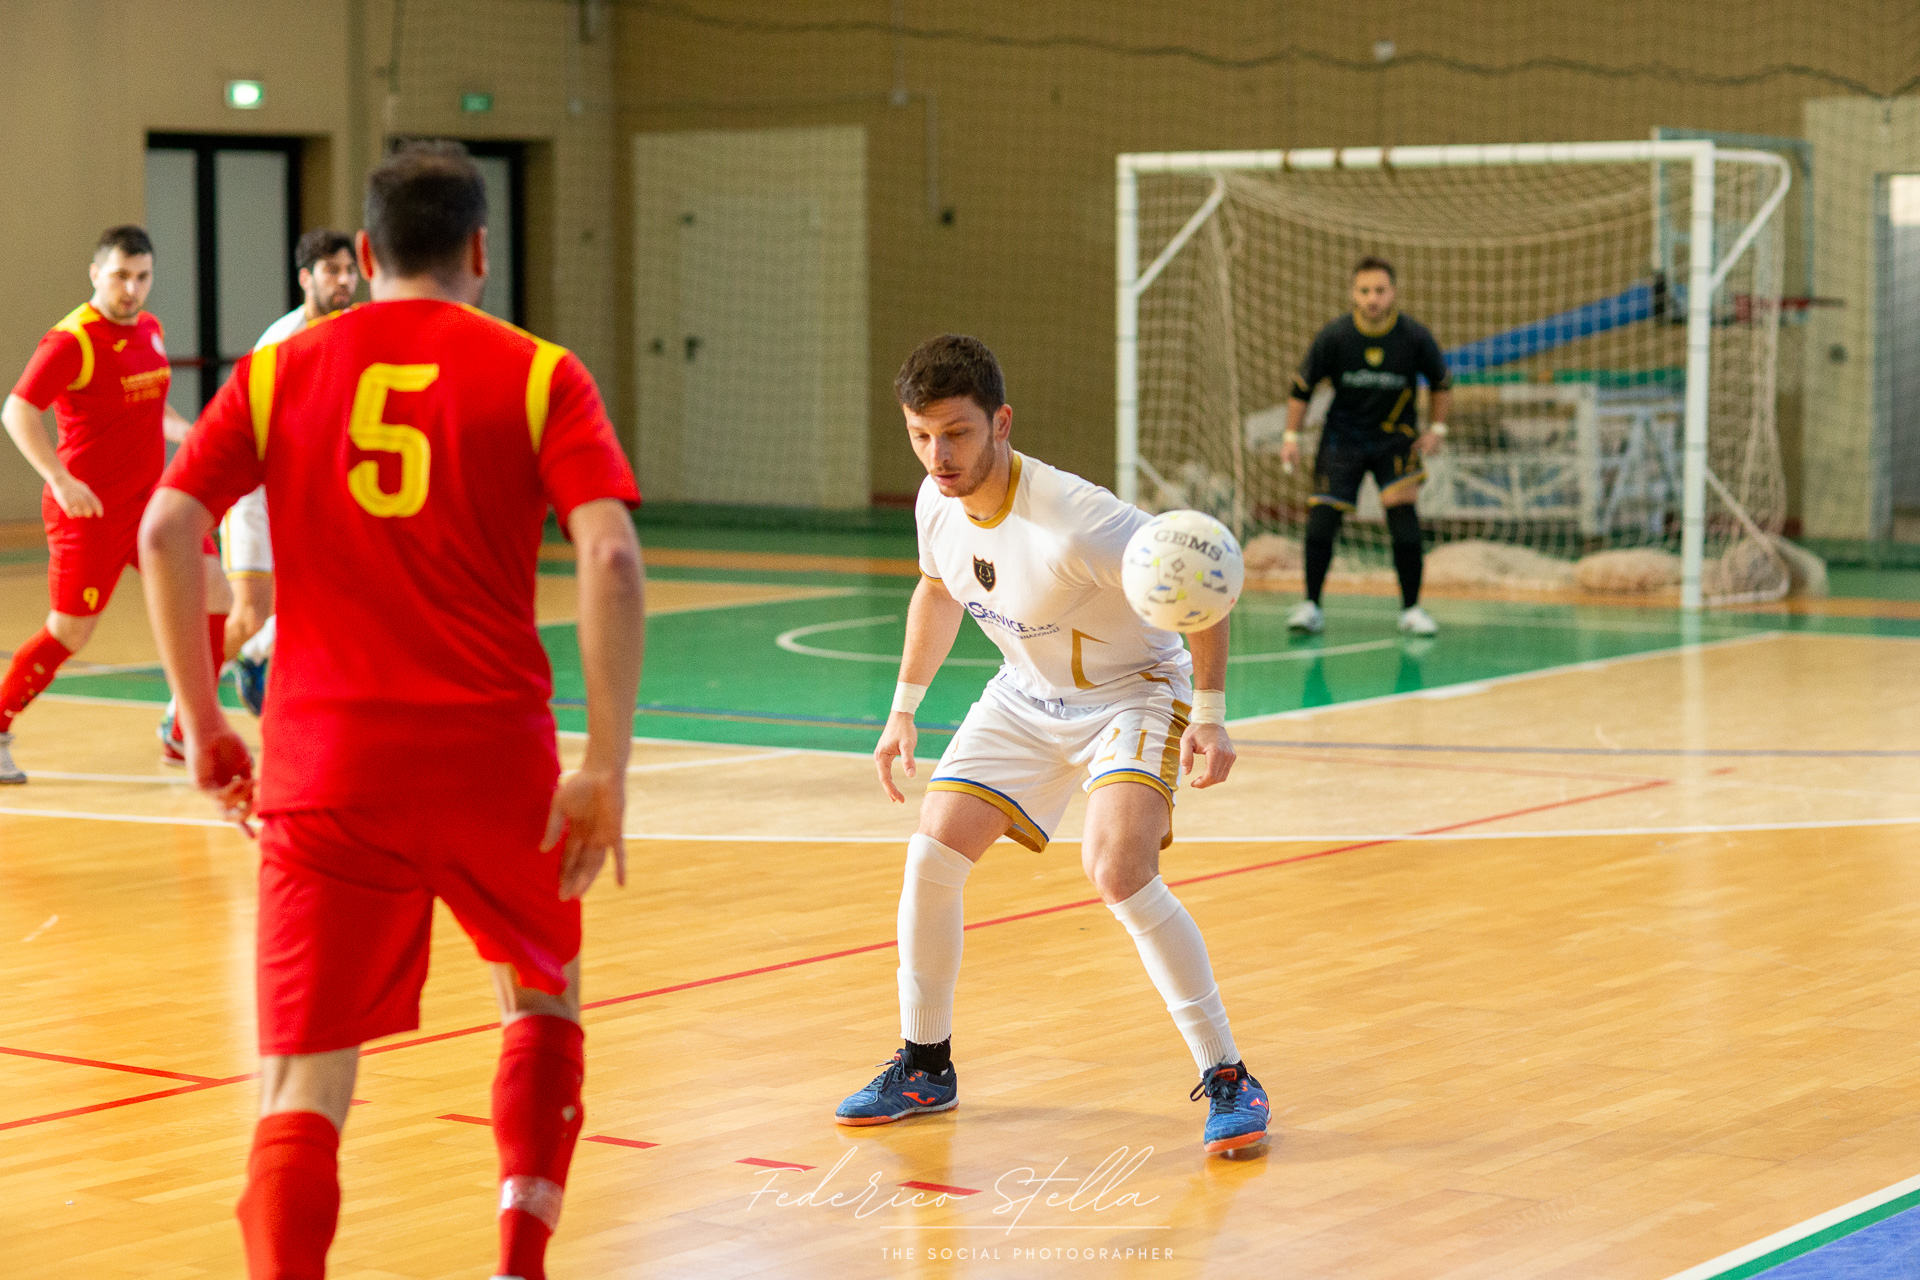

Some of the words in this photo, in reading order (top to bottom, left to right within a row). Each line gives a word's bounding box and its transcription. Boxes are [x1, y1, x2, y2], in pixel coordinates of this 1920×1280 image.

[347, 362, 440, 518] 5
[1154, 529, 1223, 562] GEMS
[82, 586, 100, 611] 9
[1096, 727, 1149, 765] 21
